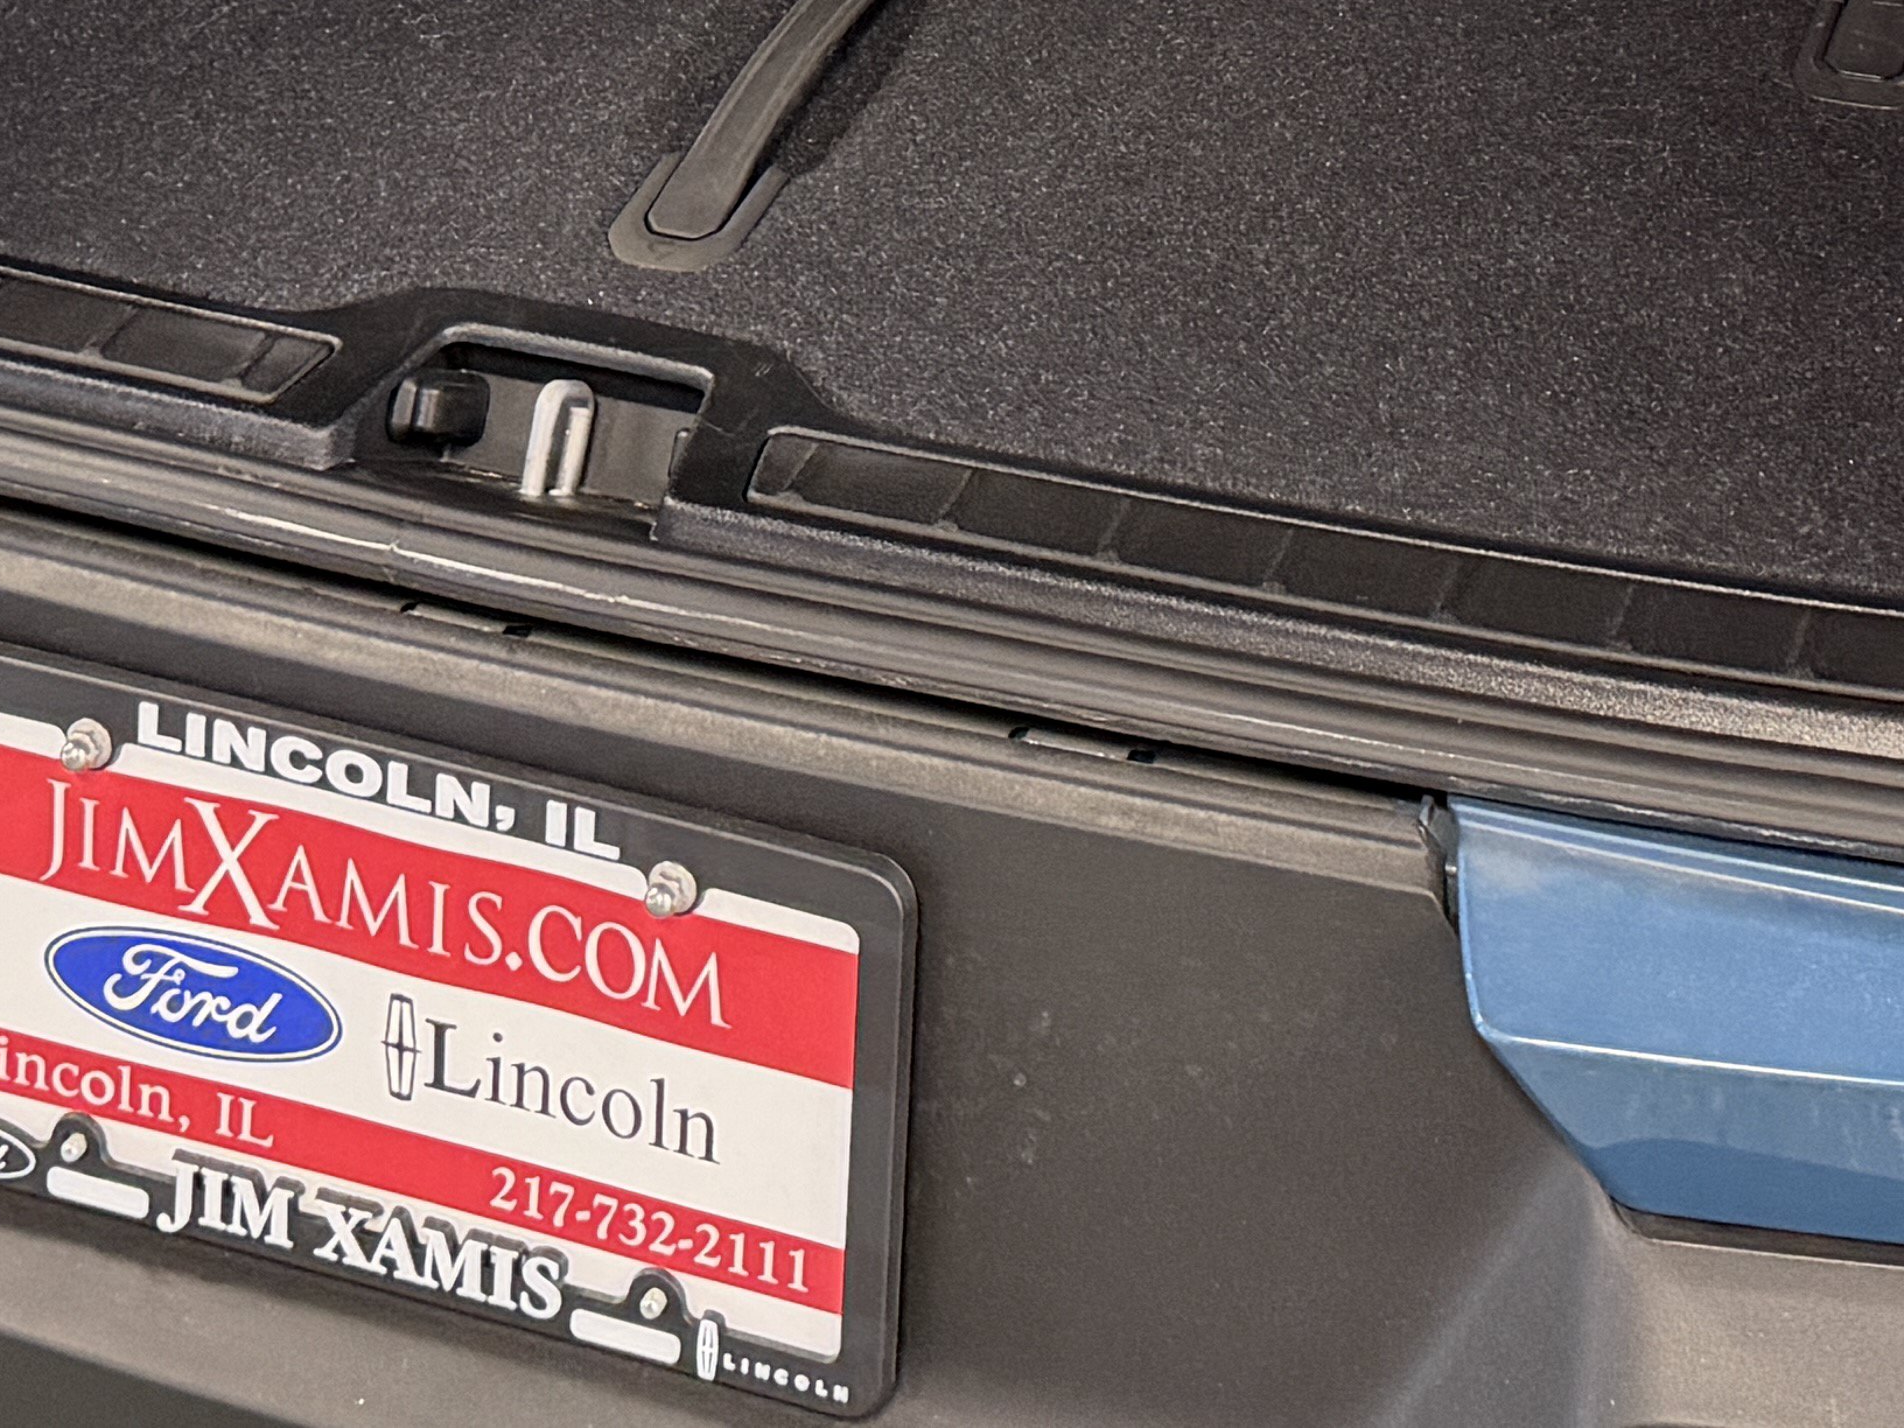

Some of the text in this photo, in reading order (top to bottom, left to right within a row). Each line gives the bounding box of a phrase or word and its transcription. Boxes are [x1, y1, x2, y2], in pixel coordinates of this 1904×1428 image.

[138, 701, 620, 861] LINCOLN, IL
[103, 943, 284, 1044] Ford
[215, 1092, 274, 1148] IL
[424, 1017, 721, 1165] Lincoln
[156, 1157, 563, 1319] JIM XAMIS
[490, 1166, 809, 1292] 217-732-2111
[723, 1353, 849, 1403] LINCOLN
